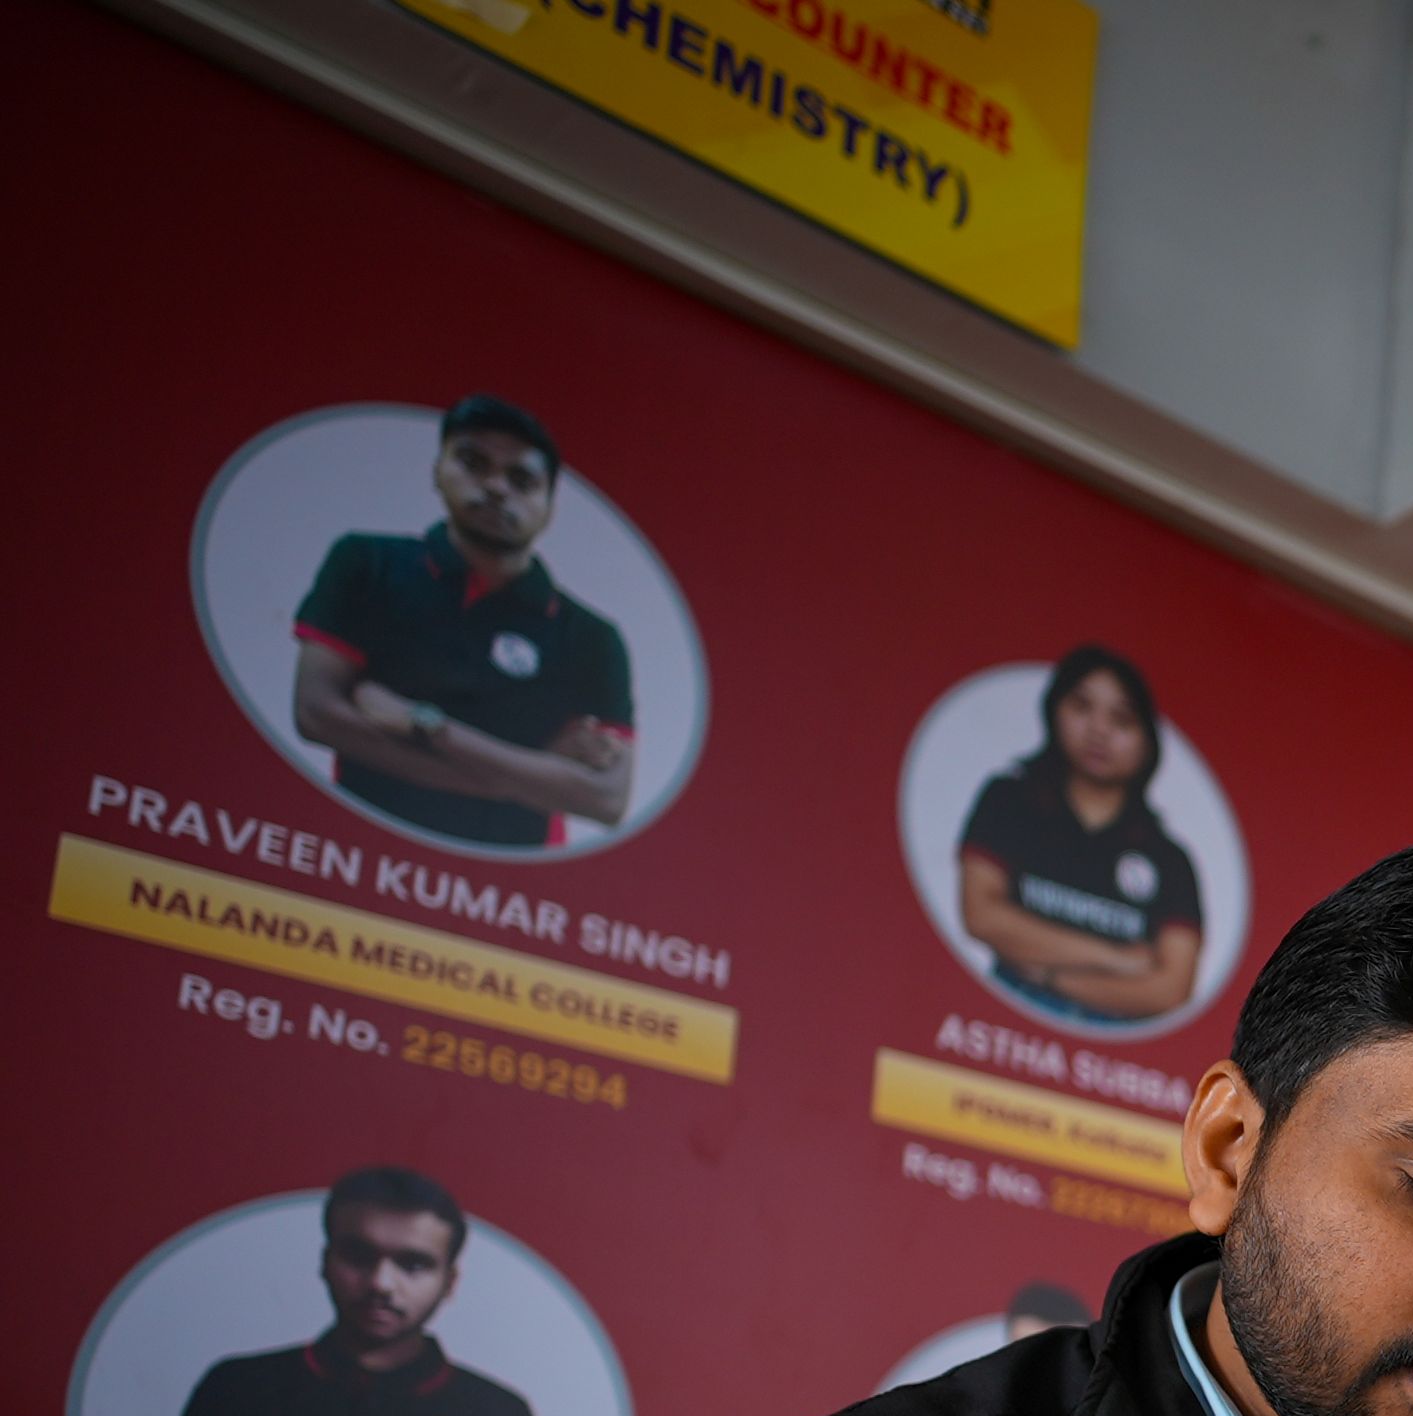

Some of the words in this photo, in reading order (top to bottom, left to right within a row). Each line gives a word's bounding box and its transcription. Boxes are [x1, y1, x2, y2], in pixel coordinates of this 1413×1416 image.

[540, 0, 971, 229] HEMISTRY)
[87, 774, 363, 887] PRAVEEN
[375, 855, 568, 945] KUMAR
[579, 913, 732, 989] SINGH
[128, 877, 340, 959] NALANDA
[350, 936, 519, 1004] MEDICAL
[529, 979, 682, 1043] COLLEGE
[177, 972, 293, 1042] Reg.
[307, 1005, 390, 1056] No.
[401, 1025, 629, 1111] 22569294
[935, 1012, 1068, 1084] ASTHA
